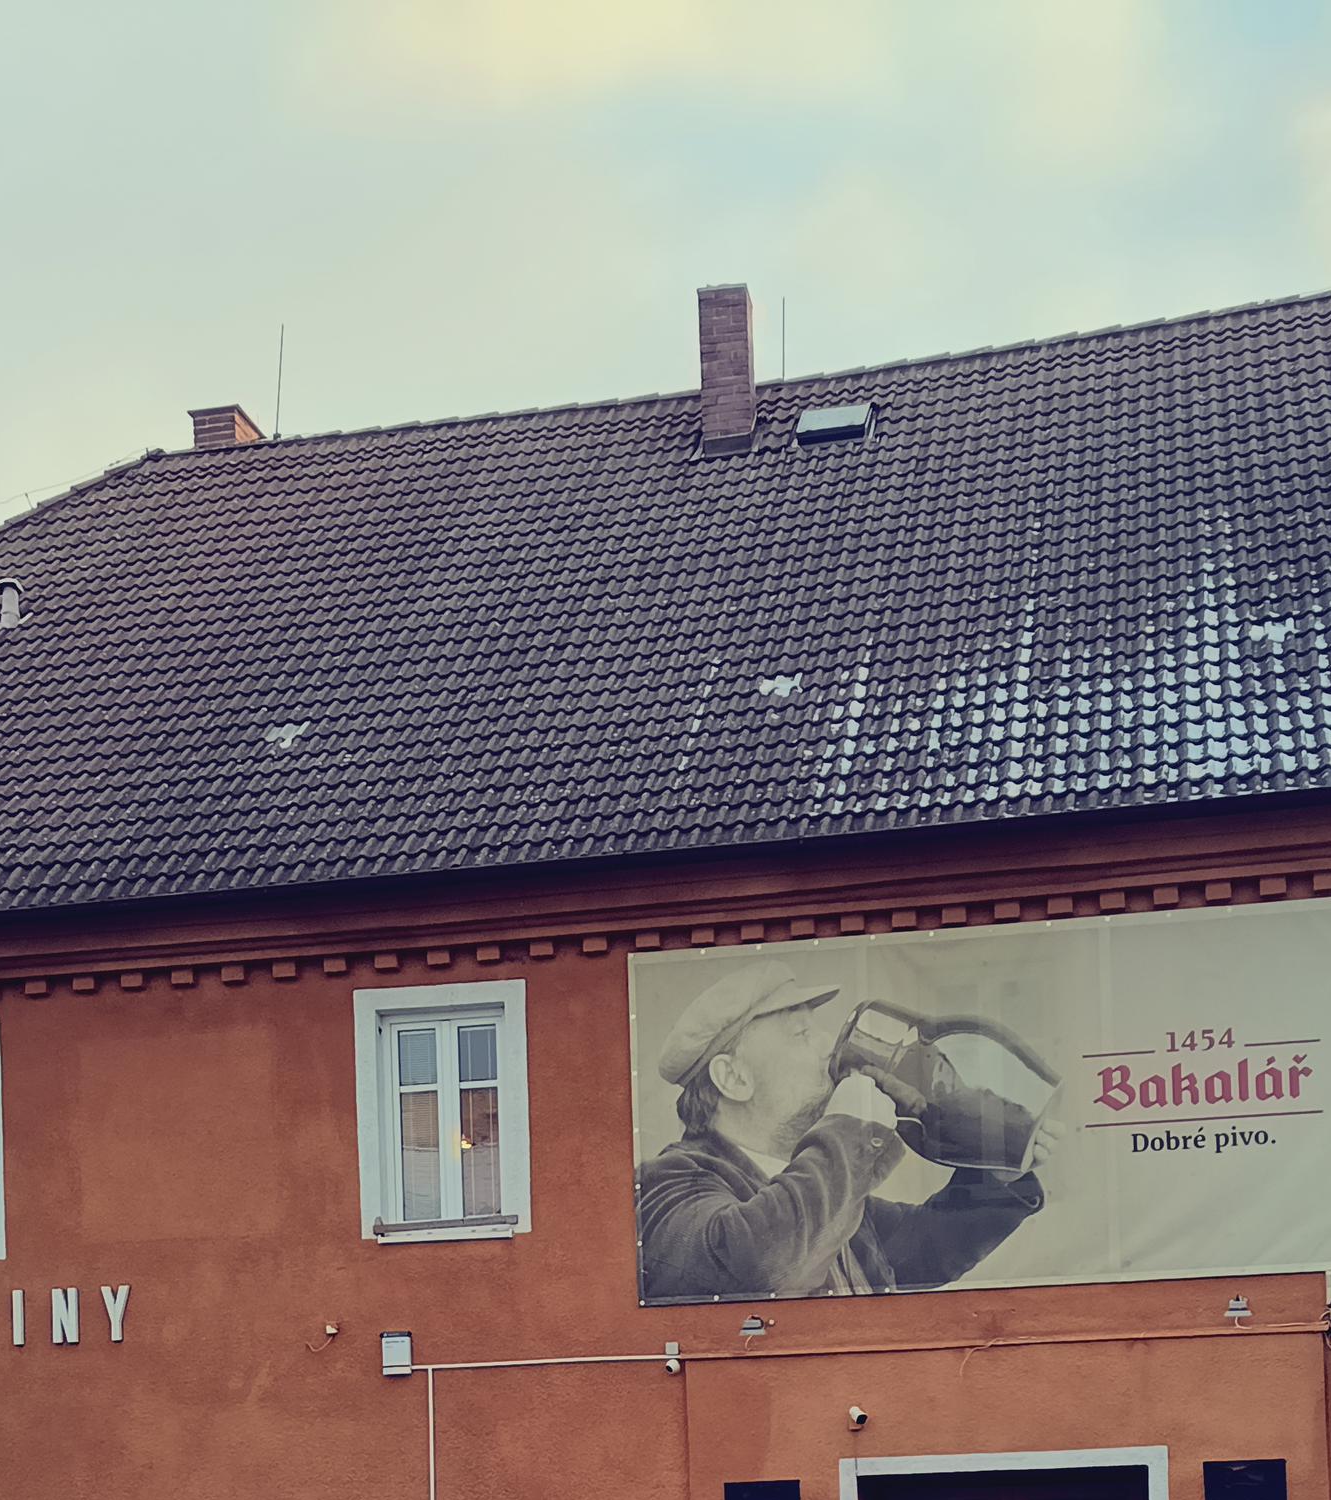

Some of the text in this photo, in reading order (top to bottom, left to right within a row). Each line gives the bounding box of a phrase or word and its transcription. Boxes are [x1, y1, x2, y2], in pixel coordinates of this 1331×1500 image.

[1166, 1028, 1235, 1052] 1454
[1093, 1054, 1313, 1111] Bakalář
[1131, 1126, 1276, 1153] Dobré pivo.
